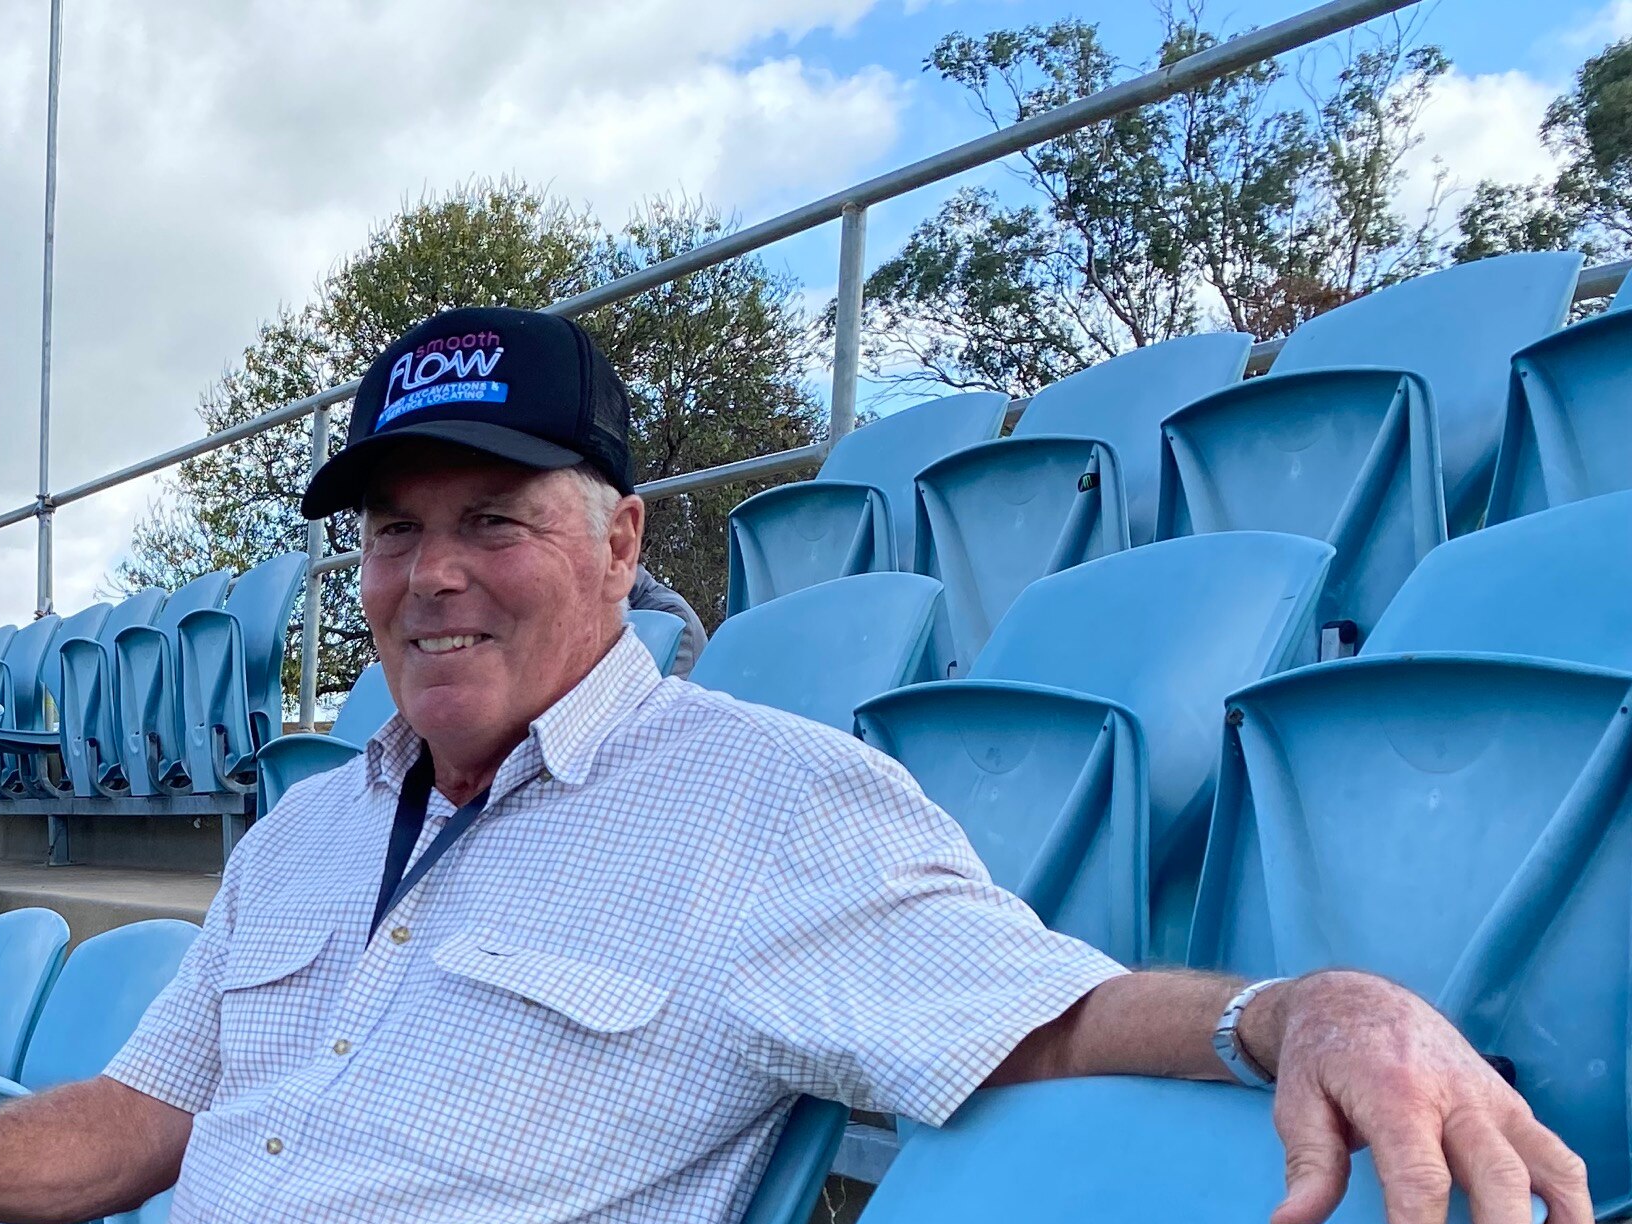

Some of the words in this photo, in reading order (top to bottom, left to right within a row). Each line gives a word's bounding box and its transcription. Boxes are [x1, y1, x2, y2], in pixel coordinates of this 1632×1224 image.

[415, 330, 501, 359] smooth
[408, 382, 487, 403] EXCAVATIONS
[426, 390, 485, 404] LOCATING
